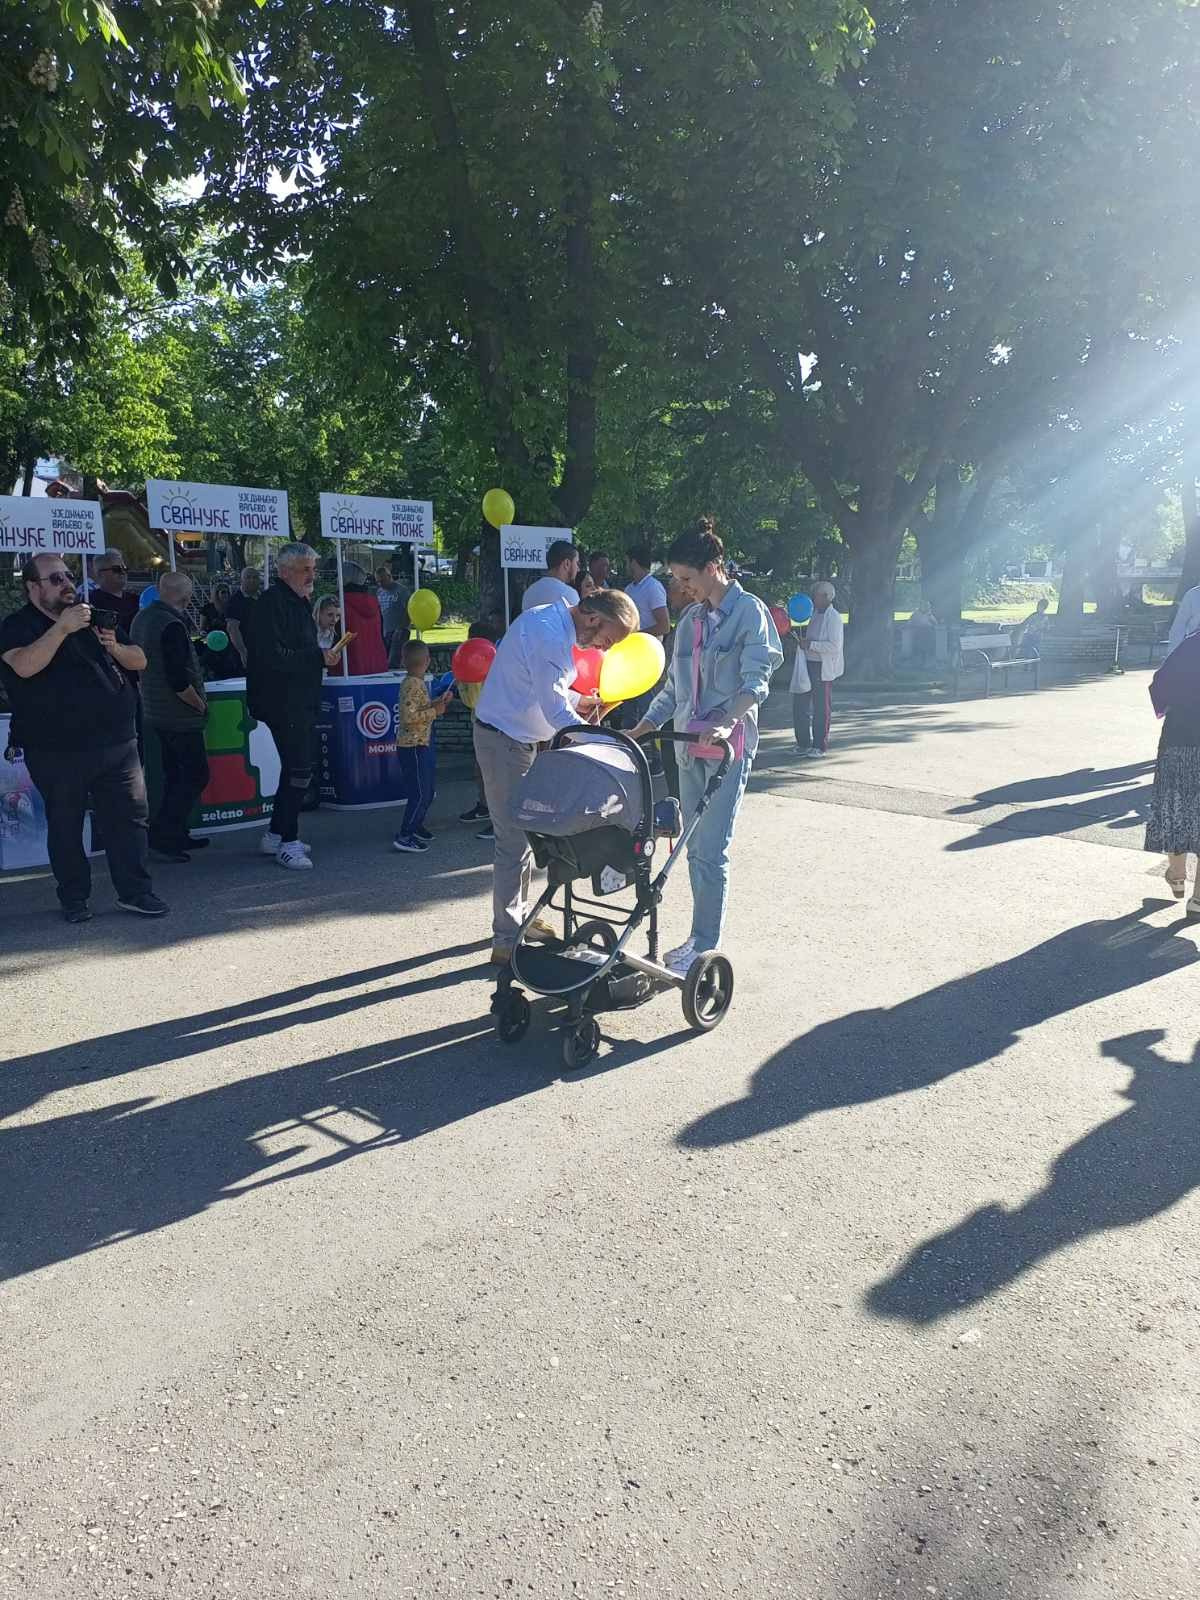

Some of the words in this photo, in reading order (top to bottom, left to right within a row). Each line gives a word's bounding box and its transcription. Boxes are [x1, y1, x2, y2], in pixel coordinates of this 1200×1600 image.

[161, 505, 231, 528] СВАНУЋЕ
[240, 513, 279, 531] МОЖЕ
[330, 516, 385, 536] СВАНУЋЕ
[392, 522, 425, 538] МОЖЕ
[53, 531, 97, 549] МОЖЕ
[504, 547, 543, 562] СВАНУЋЕ
